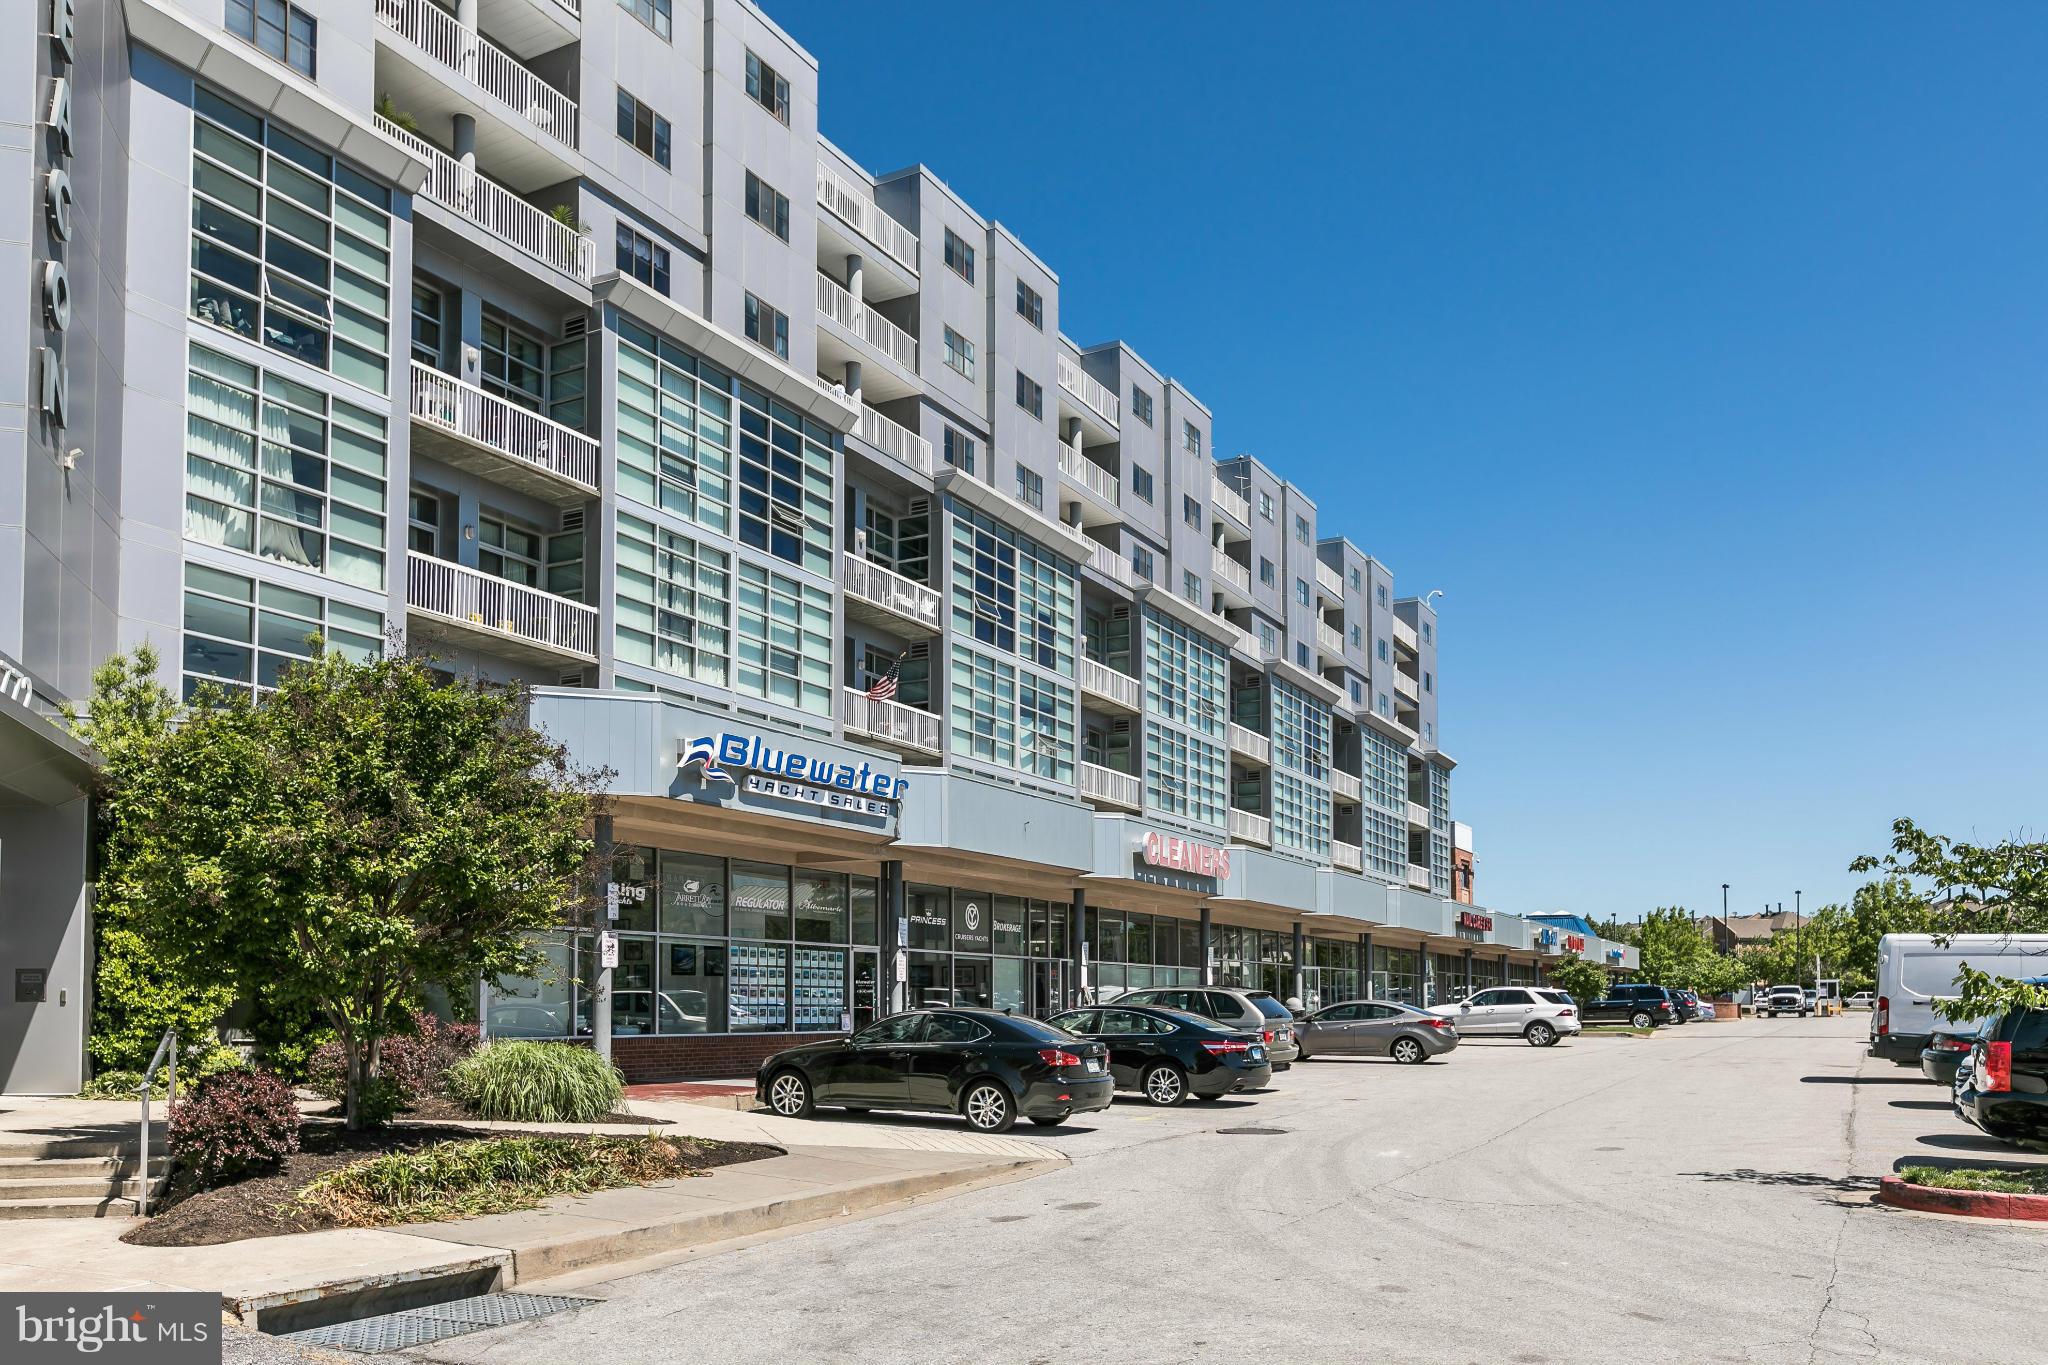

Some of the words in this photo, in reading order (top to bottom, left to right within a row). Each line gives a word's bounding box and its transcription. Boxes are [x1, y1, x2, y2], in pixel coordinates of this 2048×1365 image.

[717, 732, 909, 797] Bluewater
[749, 777, 819, 801] YACHT
[830, 794, 888, 815] SALES
[1142, 831, 1230, 880] CLEANERS
[617, 882, 646, 901] ing
[735, 896, 785, 910] REGULATOR
[910, 915, 946, 925] PRINCESS
[993, 920, 1022, 933] BROKERAGE
[954, 933, 974, 942] CRUISERS
[974, 935, 990, 943] YACHTS
